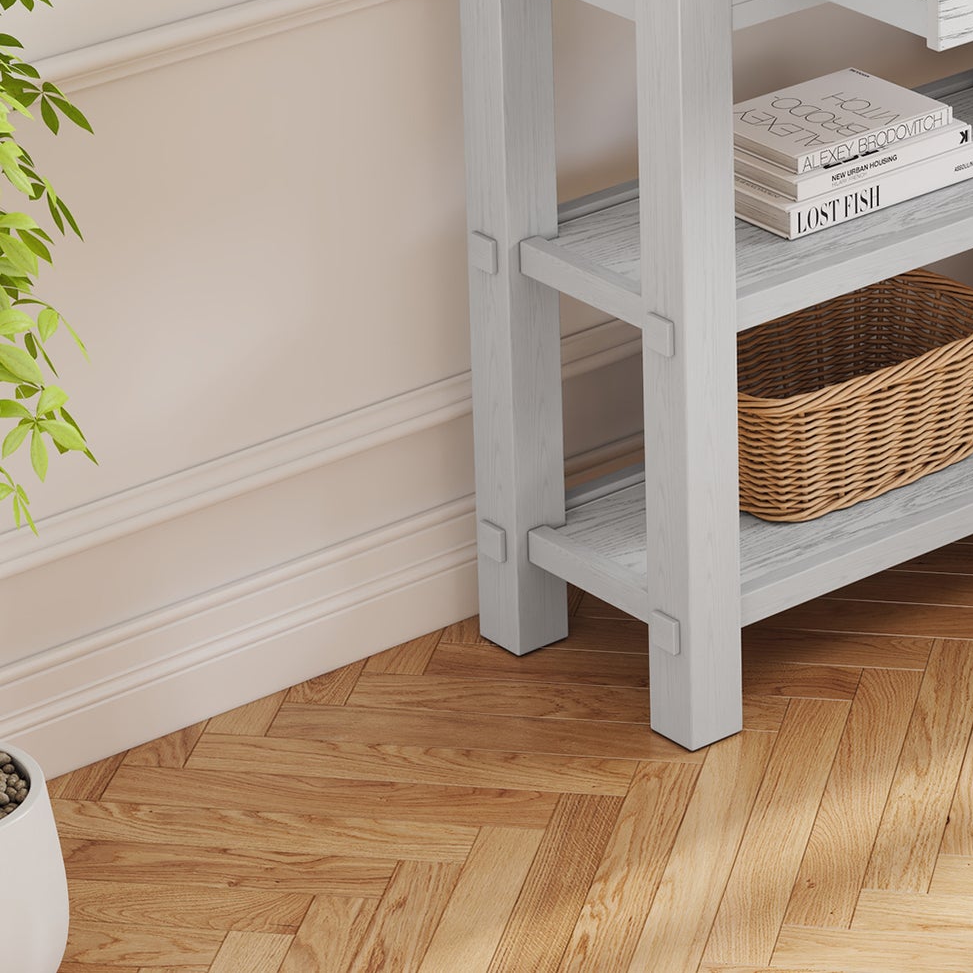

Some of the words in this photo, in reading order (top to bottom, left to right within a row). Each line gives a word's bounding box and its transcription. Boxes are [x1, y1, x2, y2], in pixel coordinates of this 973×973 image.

[802, 140, 855, 172] ALEXEY
[858, 114, 943, 153] BRODOVITCH
[831, 171, 846, 182] NEW
[847, 163, 869, 178] URBAN
[869, 154, 898, 170] HOUSING
[796, 198, 841, 234] LOST
[844, 185, 881, 218] FISH
